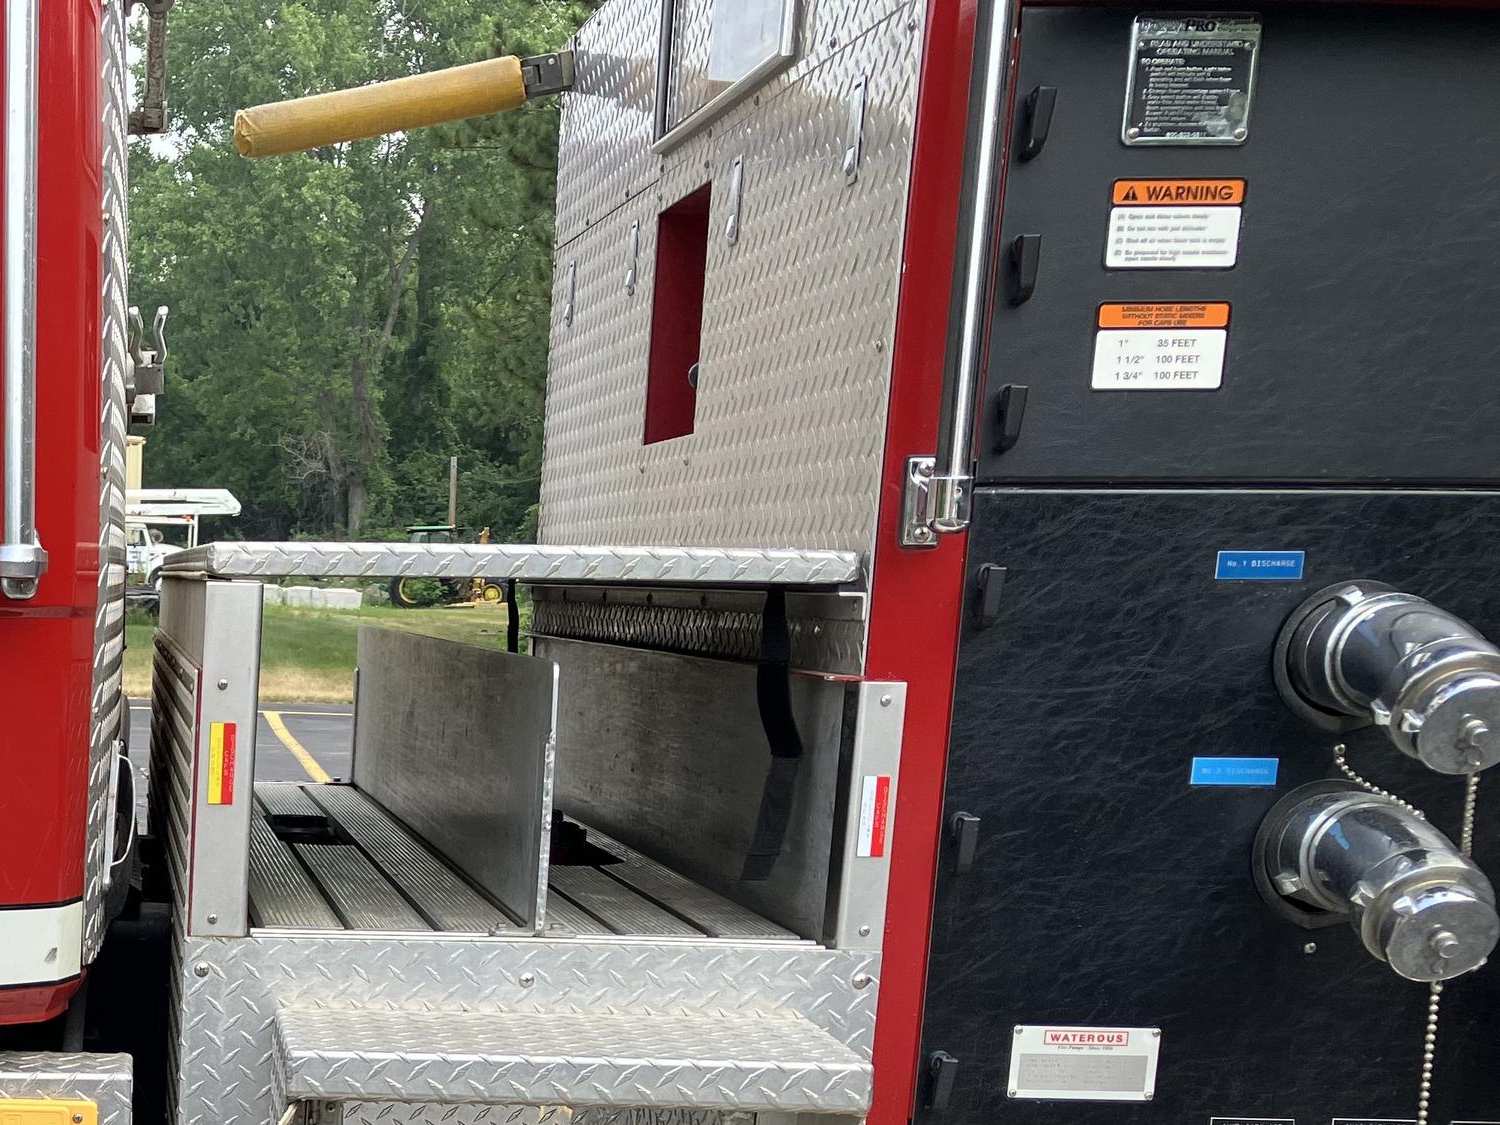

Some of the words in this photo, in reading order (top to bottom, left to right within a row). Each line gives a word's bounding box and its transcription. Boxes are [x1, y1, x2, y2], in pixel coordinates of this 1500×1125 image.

[1146, 185, 1234, 200] WARNING
[1158, 339, 1168, 347] 35
[1172, 339, 1196, 347] FEET
[1126, 356, 1144, 364] 1/2"
[1156, 355, 1172, 363] 100
[1175, 355, 1200, 363] FEET
[1123, 372, 1142, 380] 3/4"
[1154, 371, 1171, 379] 100
[1173, 371, 1198, 379] FEET
[1050, 1034, 1123, 1043] WATEROUS
